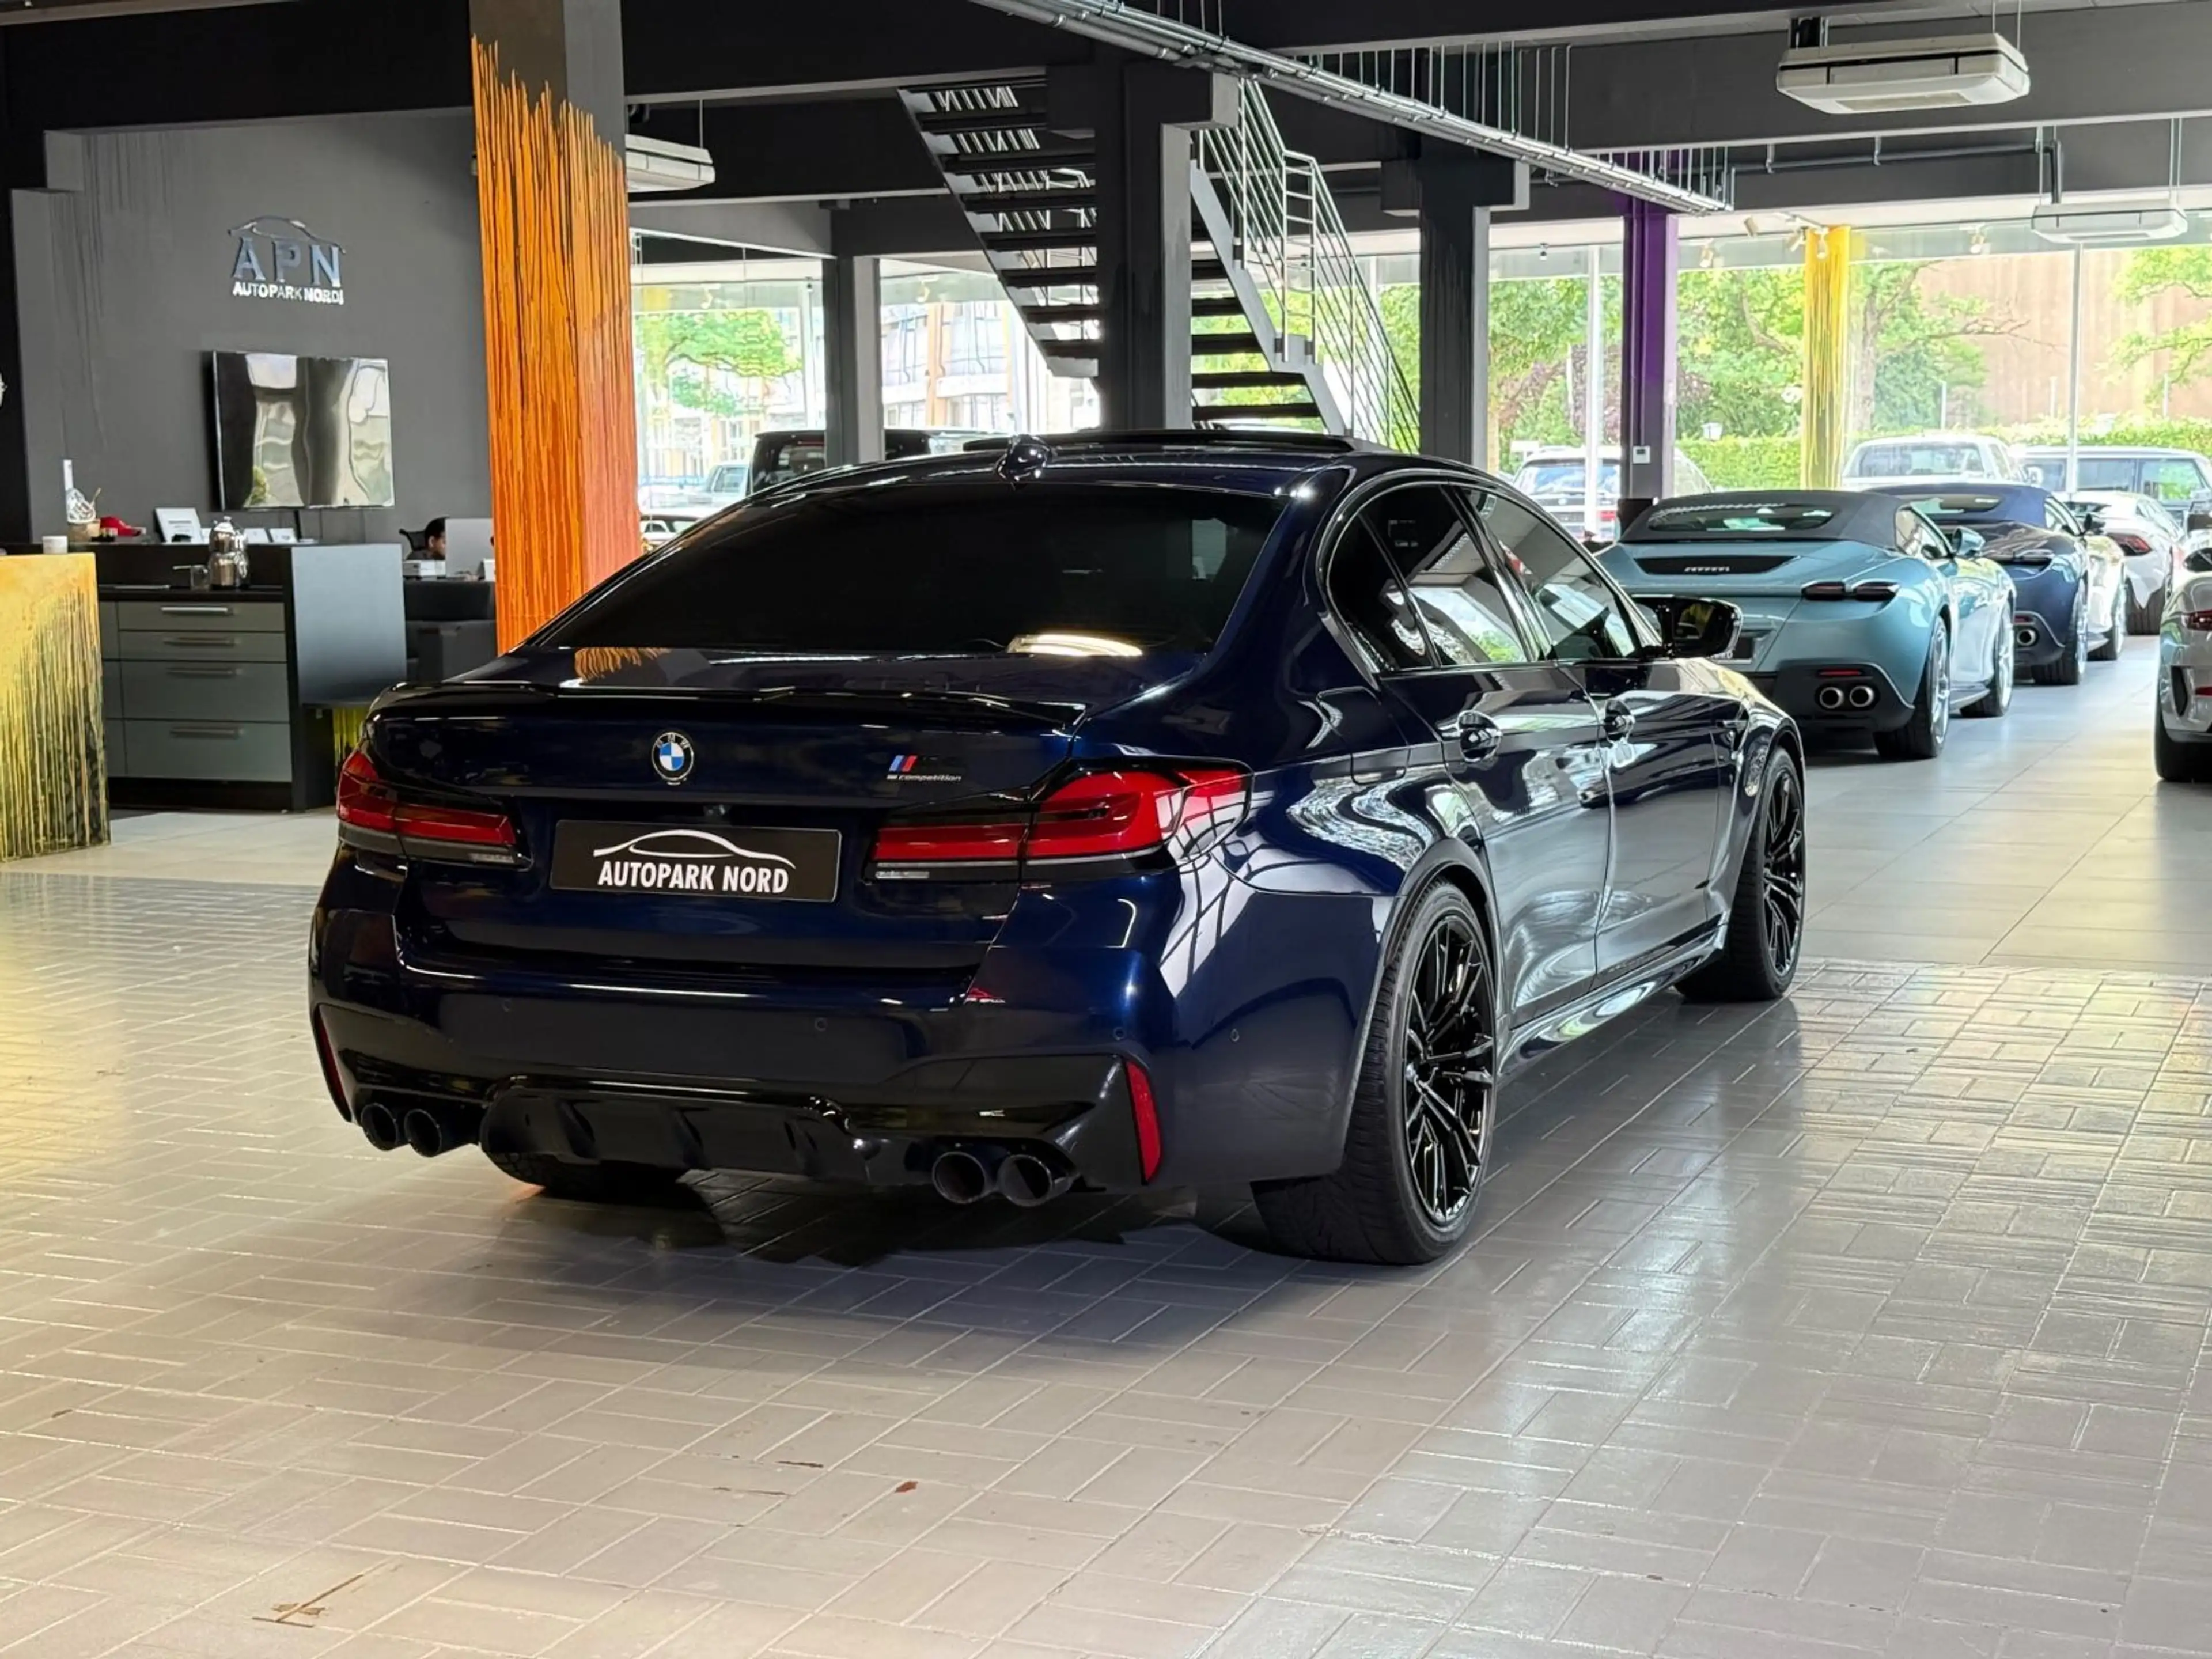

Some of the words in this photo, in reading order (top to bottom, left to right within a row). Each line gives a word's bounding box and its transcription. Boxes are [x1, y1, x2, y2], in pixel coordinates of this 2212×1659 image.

[232, 237, 342, 287] APN
[233, 281, 302, 300] AUTOPARK
[597, 861, 715, 890] AUTOPARK
[722, 865, 789, 893] NORD
